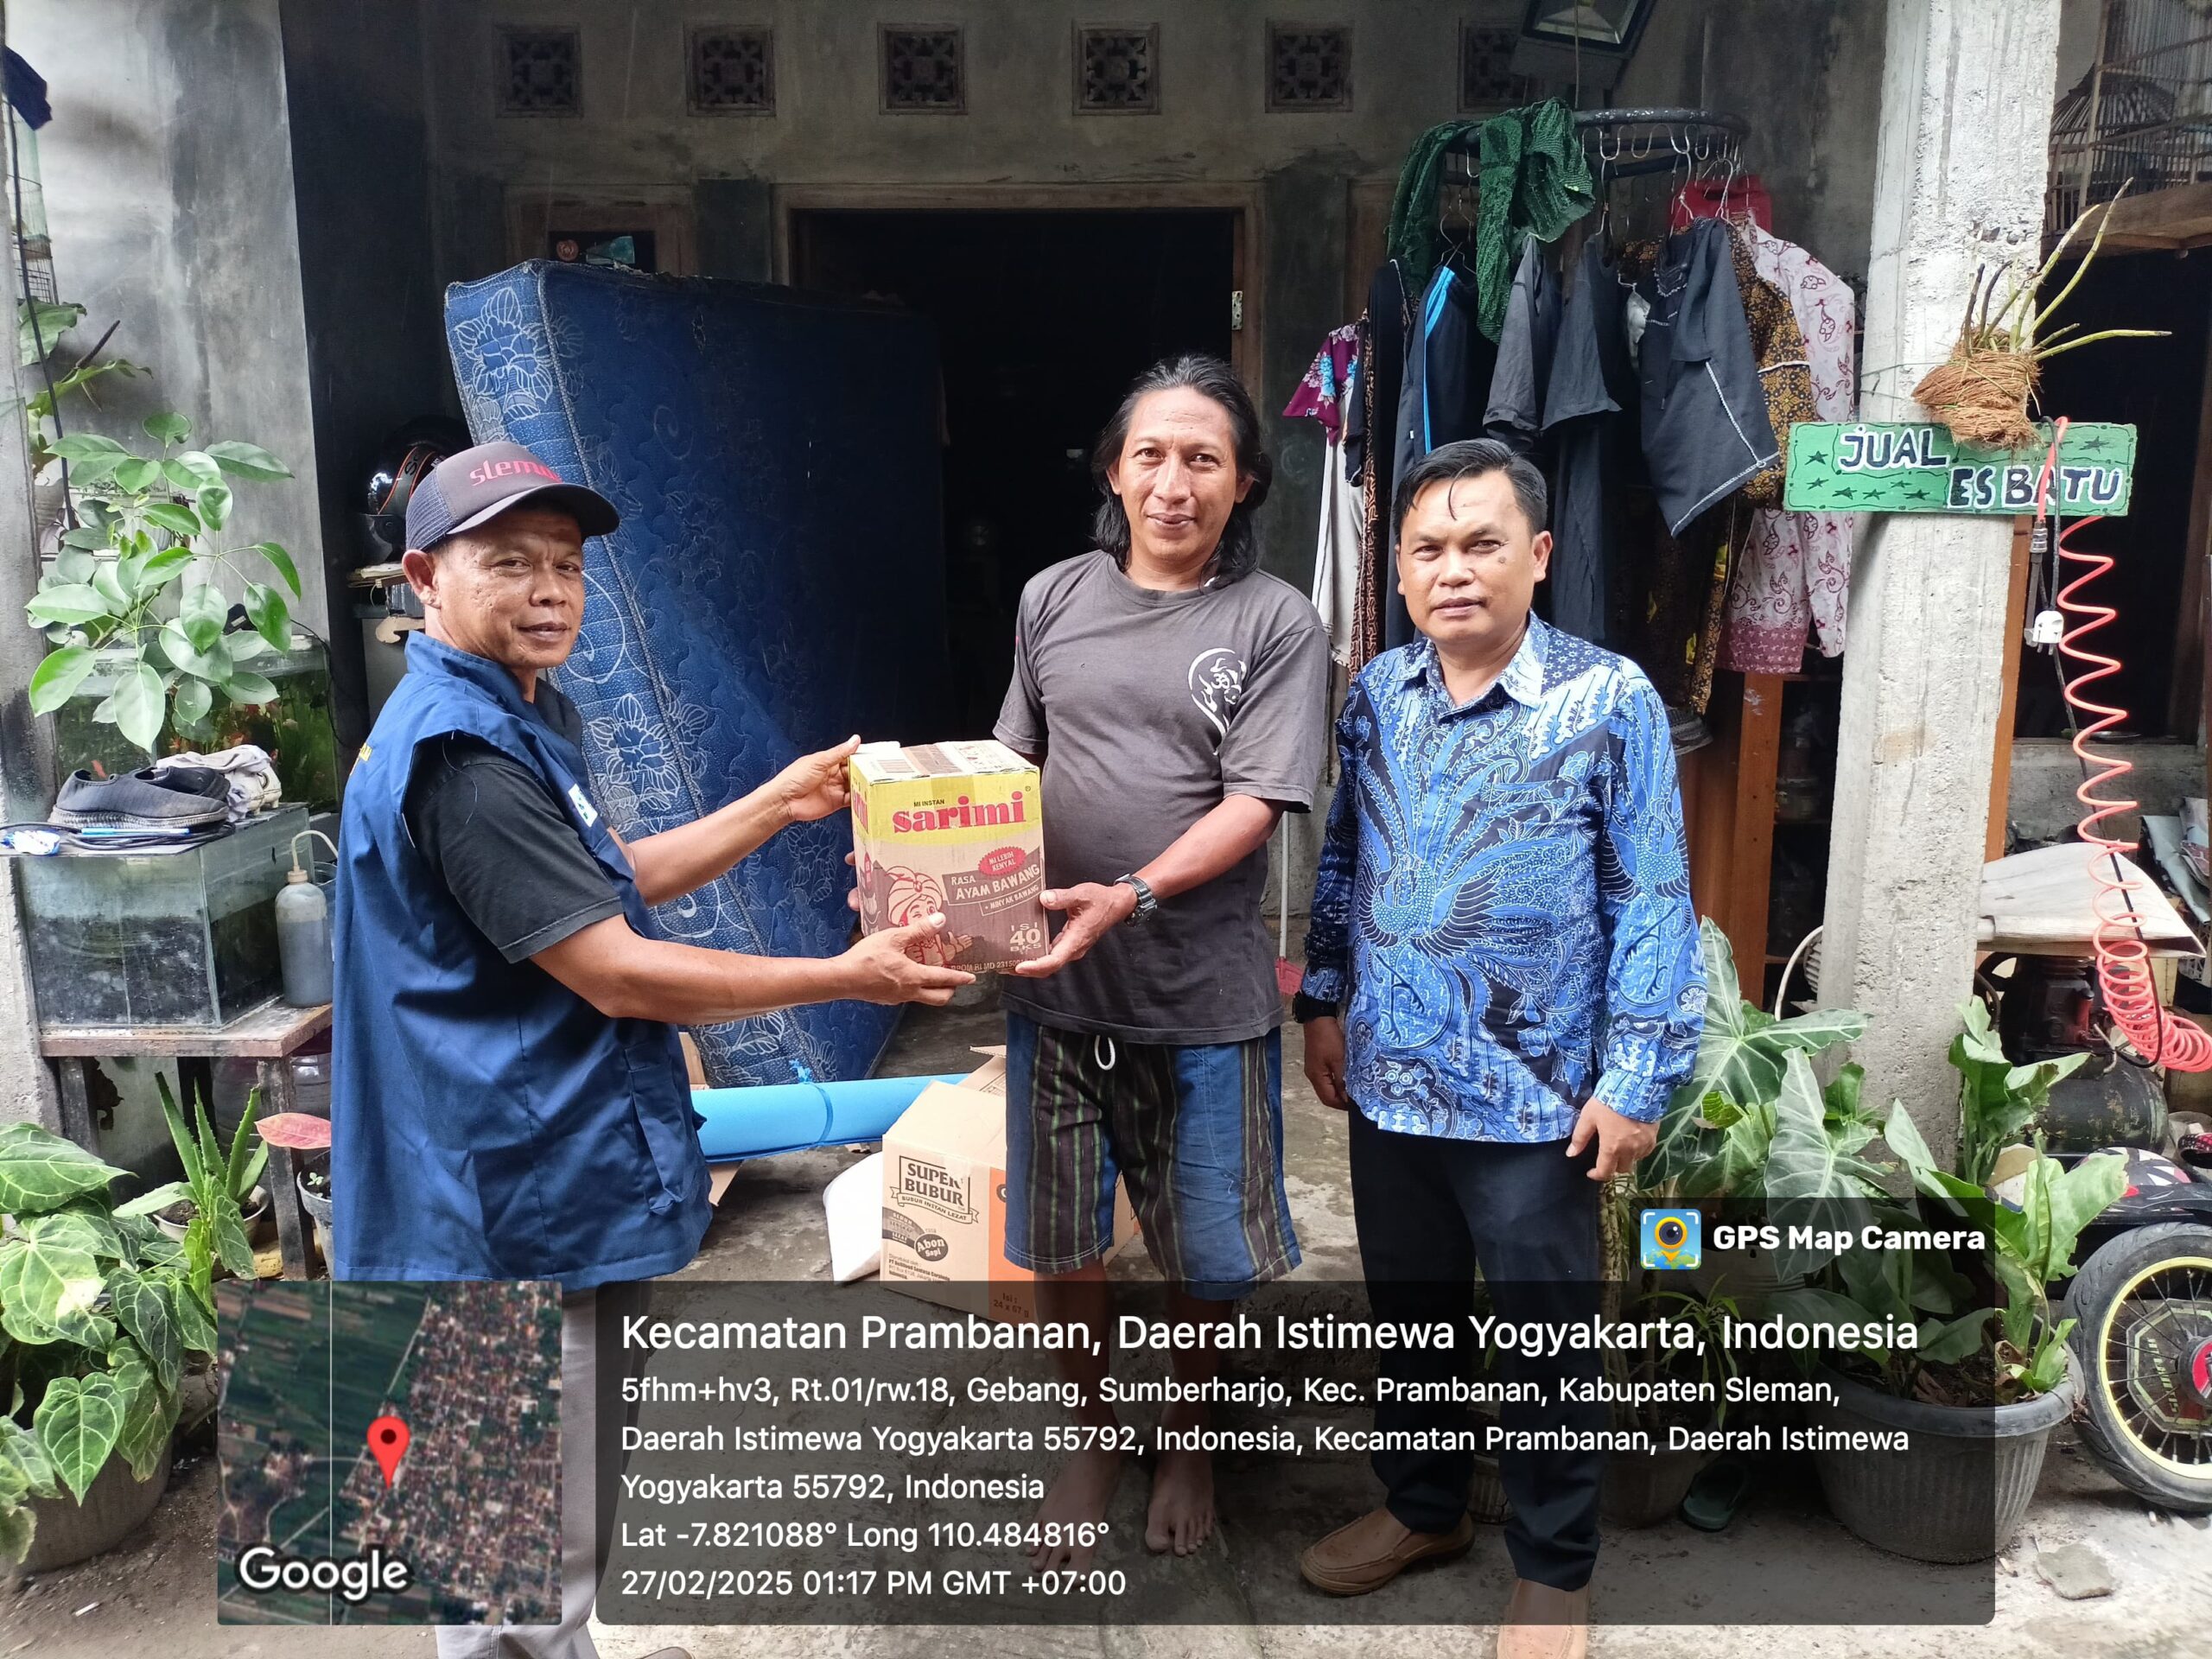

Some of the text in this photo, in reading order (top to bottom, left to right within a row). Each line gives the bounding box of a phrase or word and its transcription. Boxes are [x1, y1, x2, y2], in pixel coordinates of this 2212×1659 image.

[1838, 426, 1950, 470] JUAL
[1948, 467, 1996, 509] ES
[892, 791, 1027, 834] sarimi
[992, 859, 1016, 872] KENYAL
[951, 875, 976, 886] RASA
[956, 863, 1040, 900] AYAM BAWANG
[990, 884, 1039, 910] MINYAK BAWANG
[1009, 928, 1041, 946] 40
[1010, 922, 1038, 931] ISI
[1010, 944, 1042, 952] BKS
[905, 1178, 964, 1206] BUBUR
[901, 1195, 923, 1206] BUBUR
[924, 1200, 946, 1213] INSTAN
[947, 1210, 967, 1221] LEZAT
[917, 1237, 945, 1253] Abon
[925, 1248, 941, 1257] Sapi
